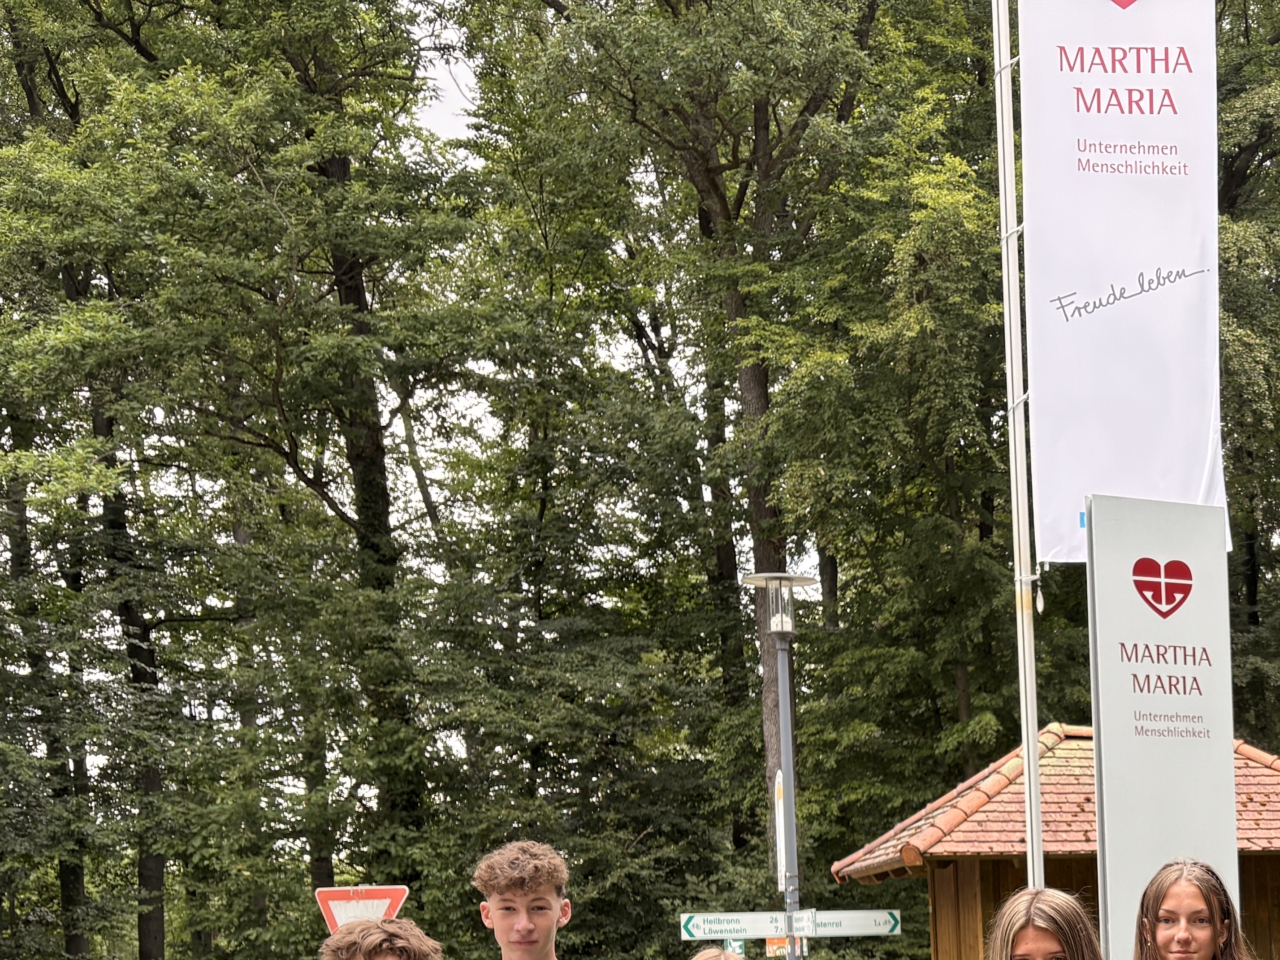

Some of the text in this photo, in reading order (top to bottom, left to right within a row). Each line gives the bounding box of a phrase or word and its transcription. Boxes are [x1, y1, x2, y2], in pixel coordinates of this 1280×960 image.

[1056, 46, 1193, 74] MARTHA
[1072, 87, 1178, 115] MARIA
[1077, 138, 1178, 156] Unternehmen
[1077, 158, 1189, 176] Menschlichkeit
[1050, 283, 1130, 322] Freude
[1118, 642, 1212, 667] MARTHA
[1131, 673, 1203, 697] MARIA
[1134, 710, 1203, 724] Unternehmen
[1134, 726, 1211, 739] Menschlichkeit
[703, 916, 778, 925] Heilbronn 26
[703, 926, 747, 935] Löwenstein
